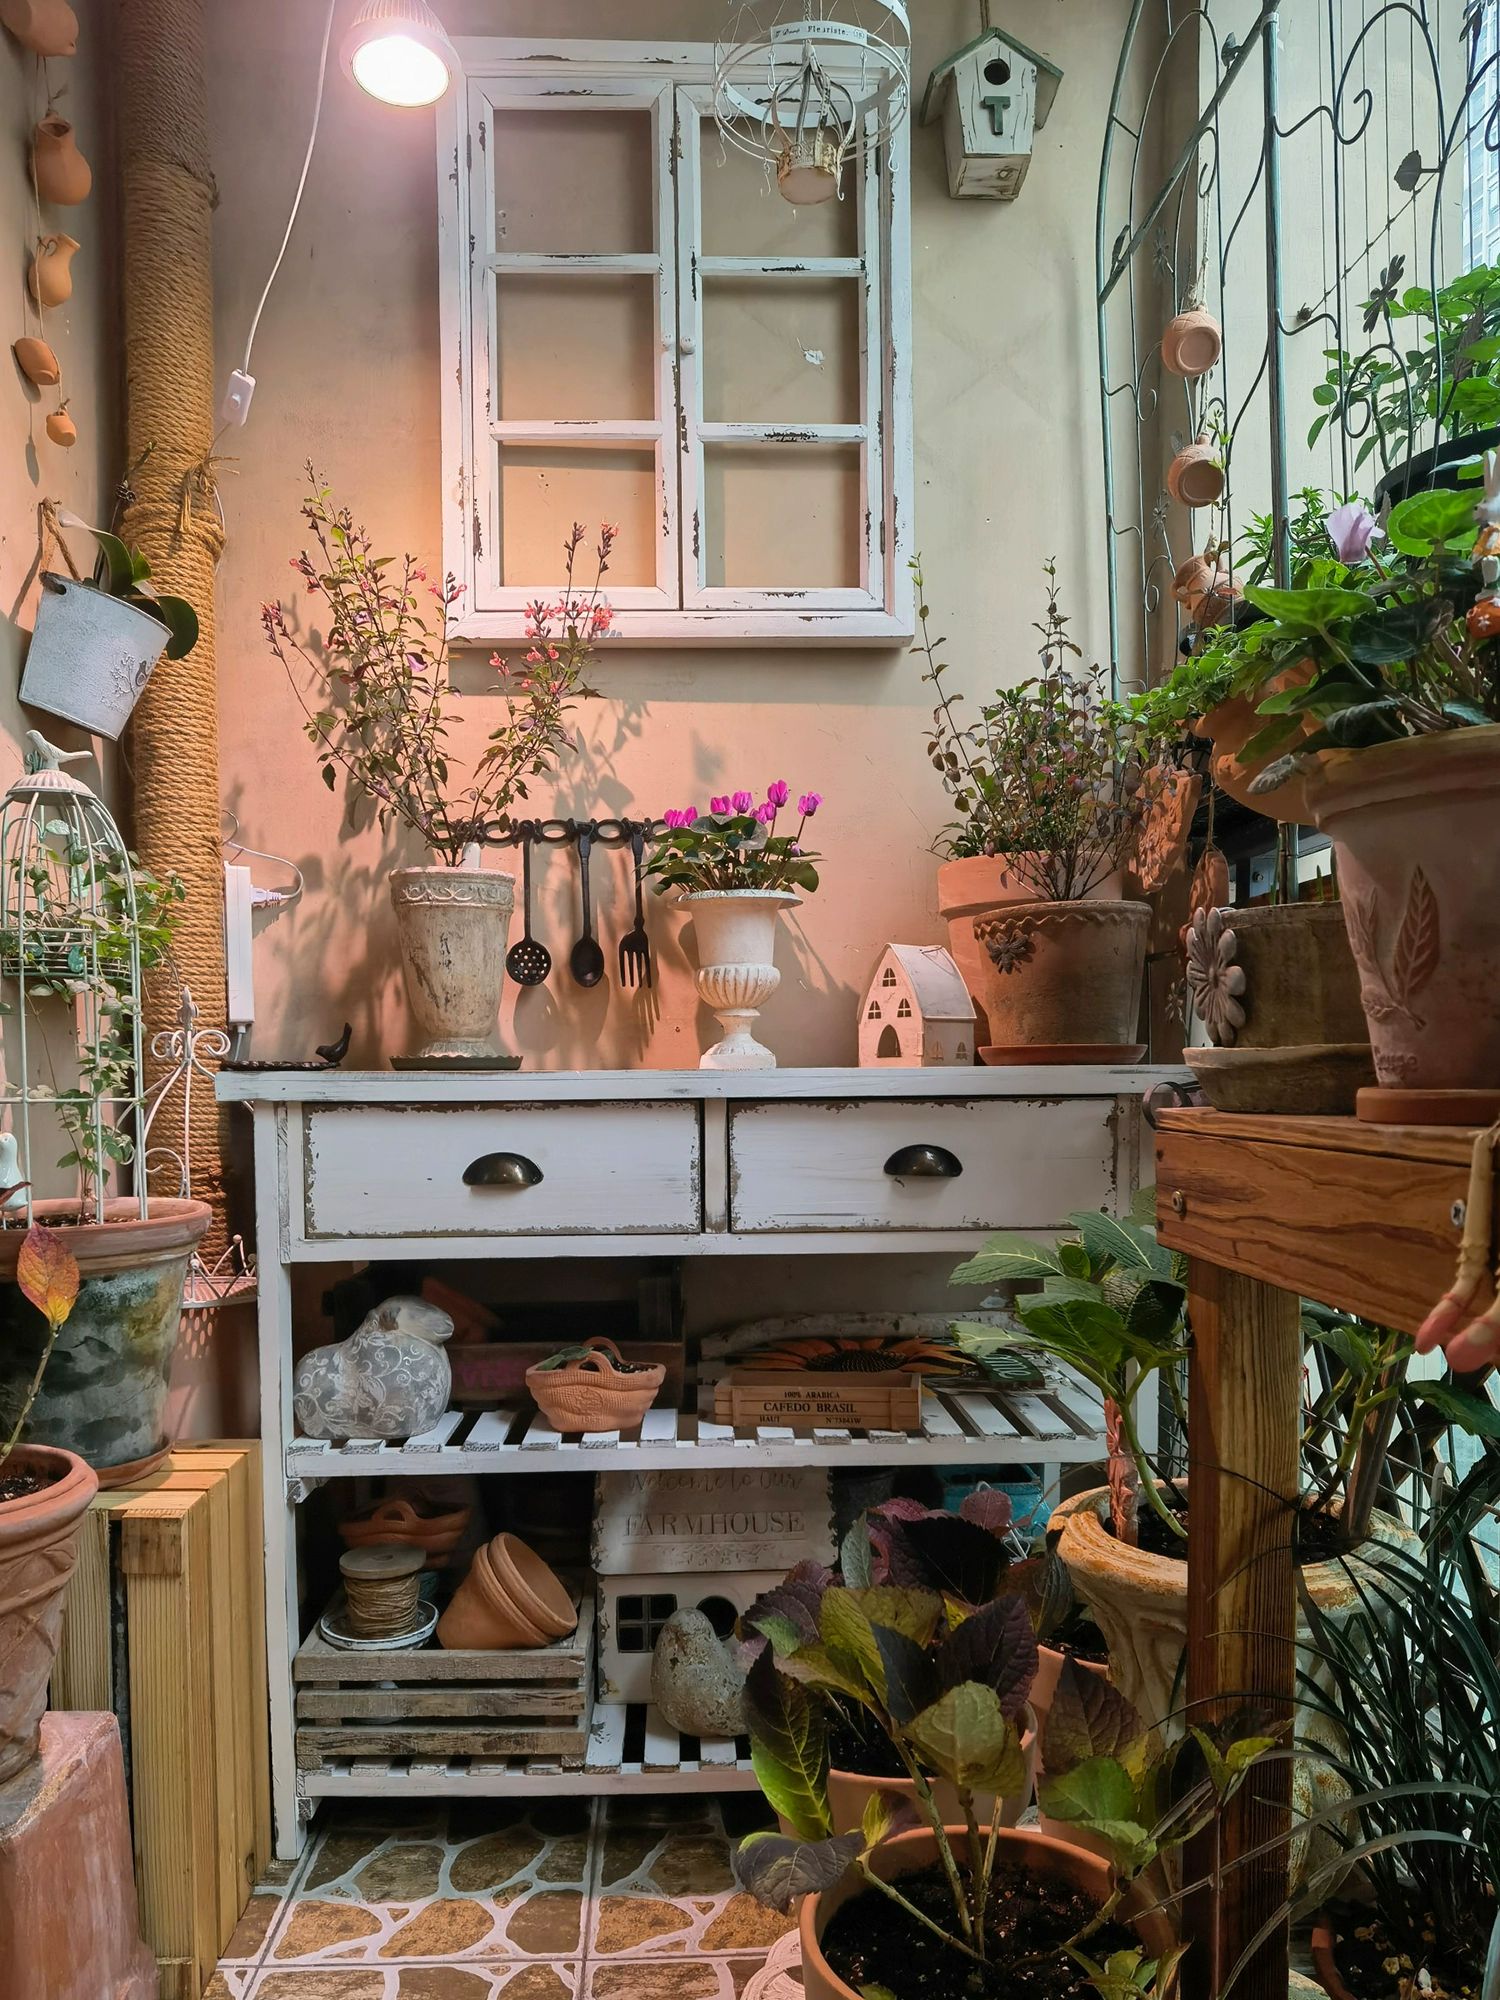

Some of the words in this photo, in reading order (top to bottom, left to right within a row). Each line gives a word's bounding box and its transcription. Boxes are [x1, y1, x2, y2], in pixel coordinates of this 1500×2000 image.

[983, 96, 1011, 136] T
[805, 1391, 840, 1400] ARABICA
[816, 1403, 857, 1413] BRASIL
[630, 1473, 726, 1494] Welcome
[624, 1511, 805, 1538] FARMHOUSE
